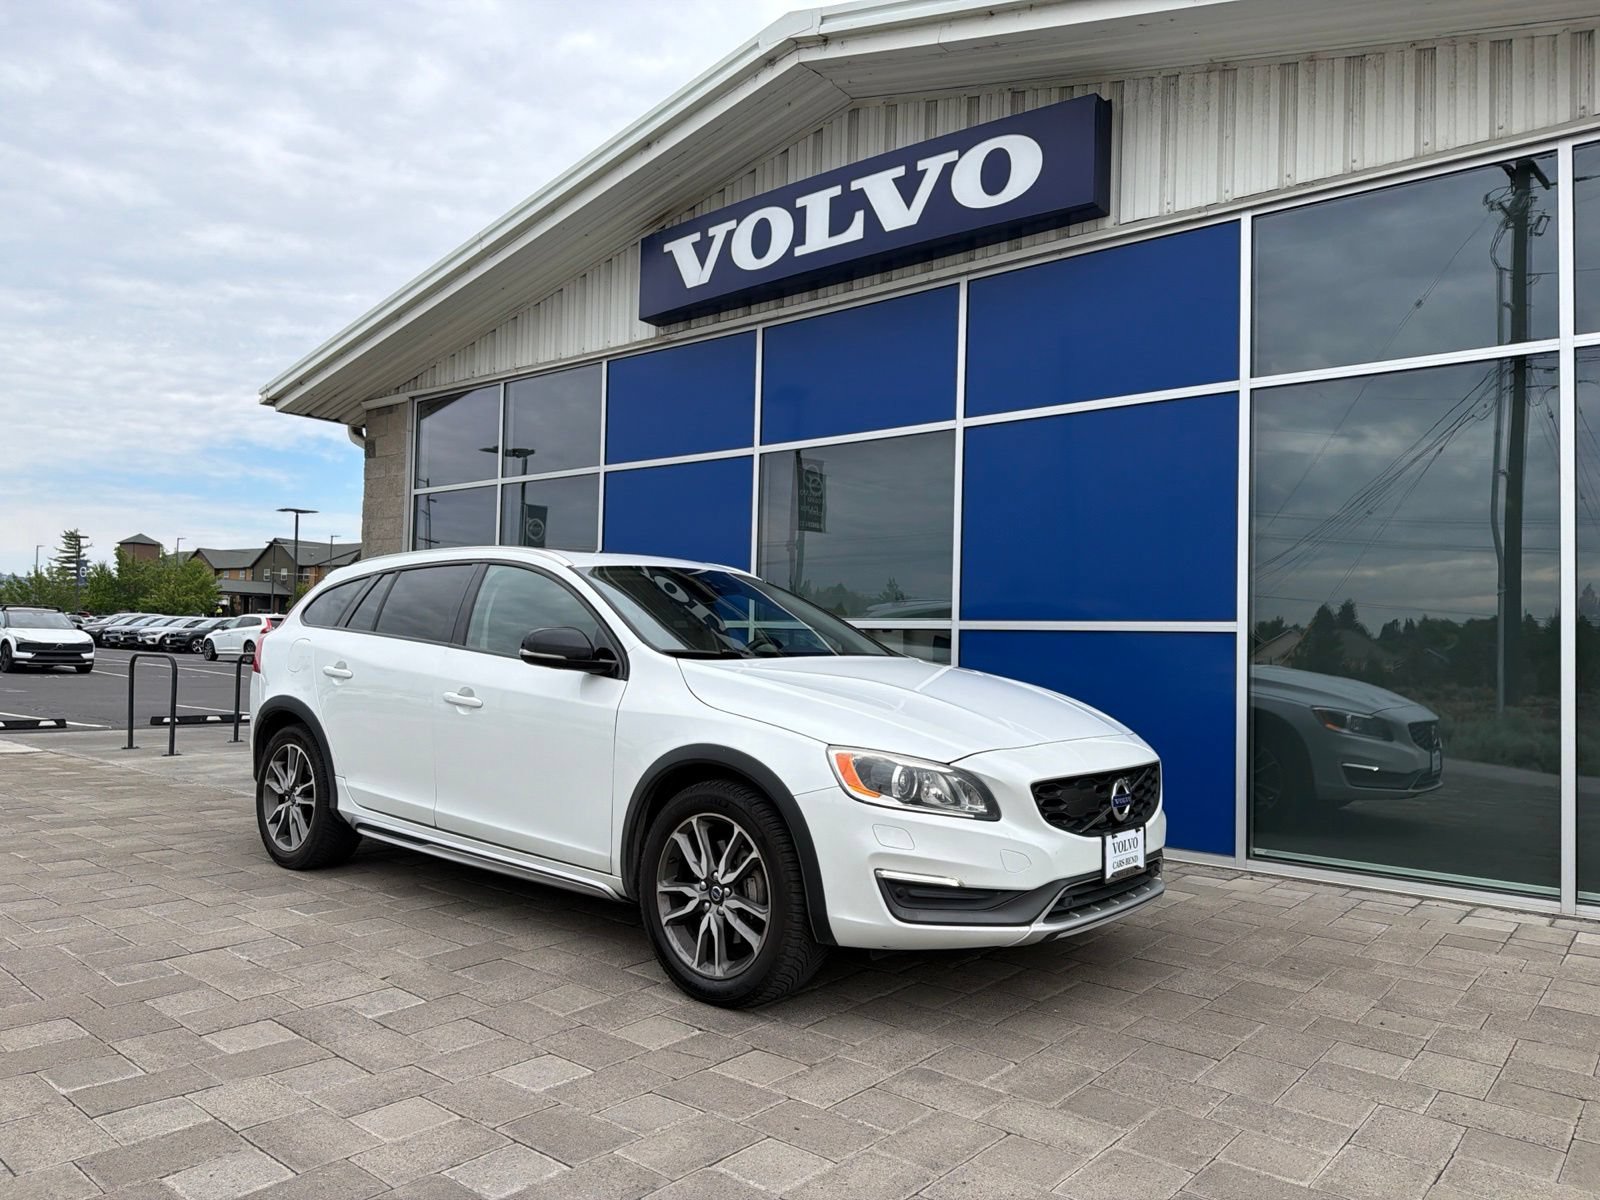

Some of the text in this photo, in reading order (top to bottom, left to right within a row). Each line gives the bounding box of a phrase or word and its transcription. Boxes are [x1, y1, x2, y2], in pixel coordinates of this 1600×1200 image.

[663, 134, 1043, 289] VOLVO
[1112, 837, 1139, 854] VOLVO
[1112, 854, 1139, 870] CARS BEND
